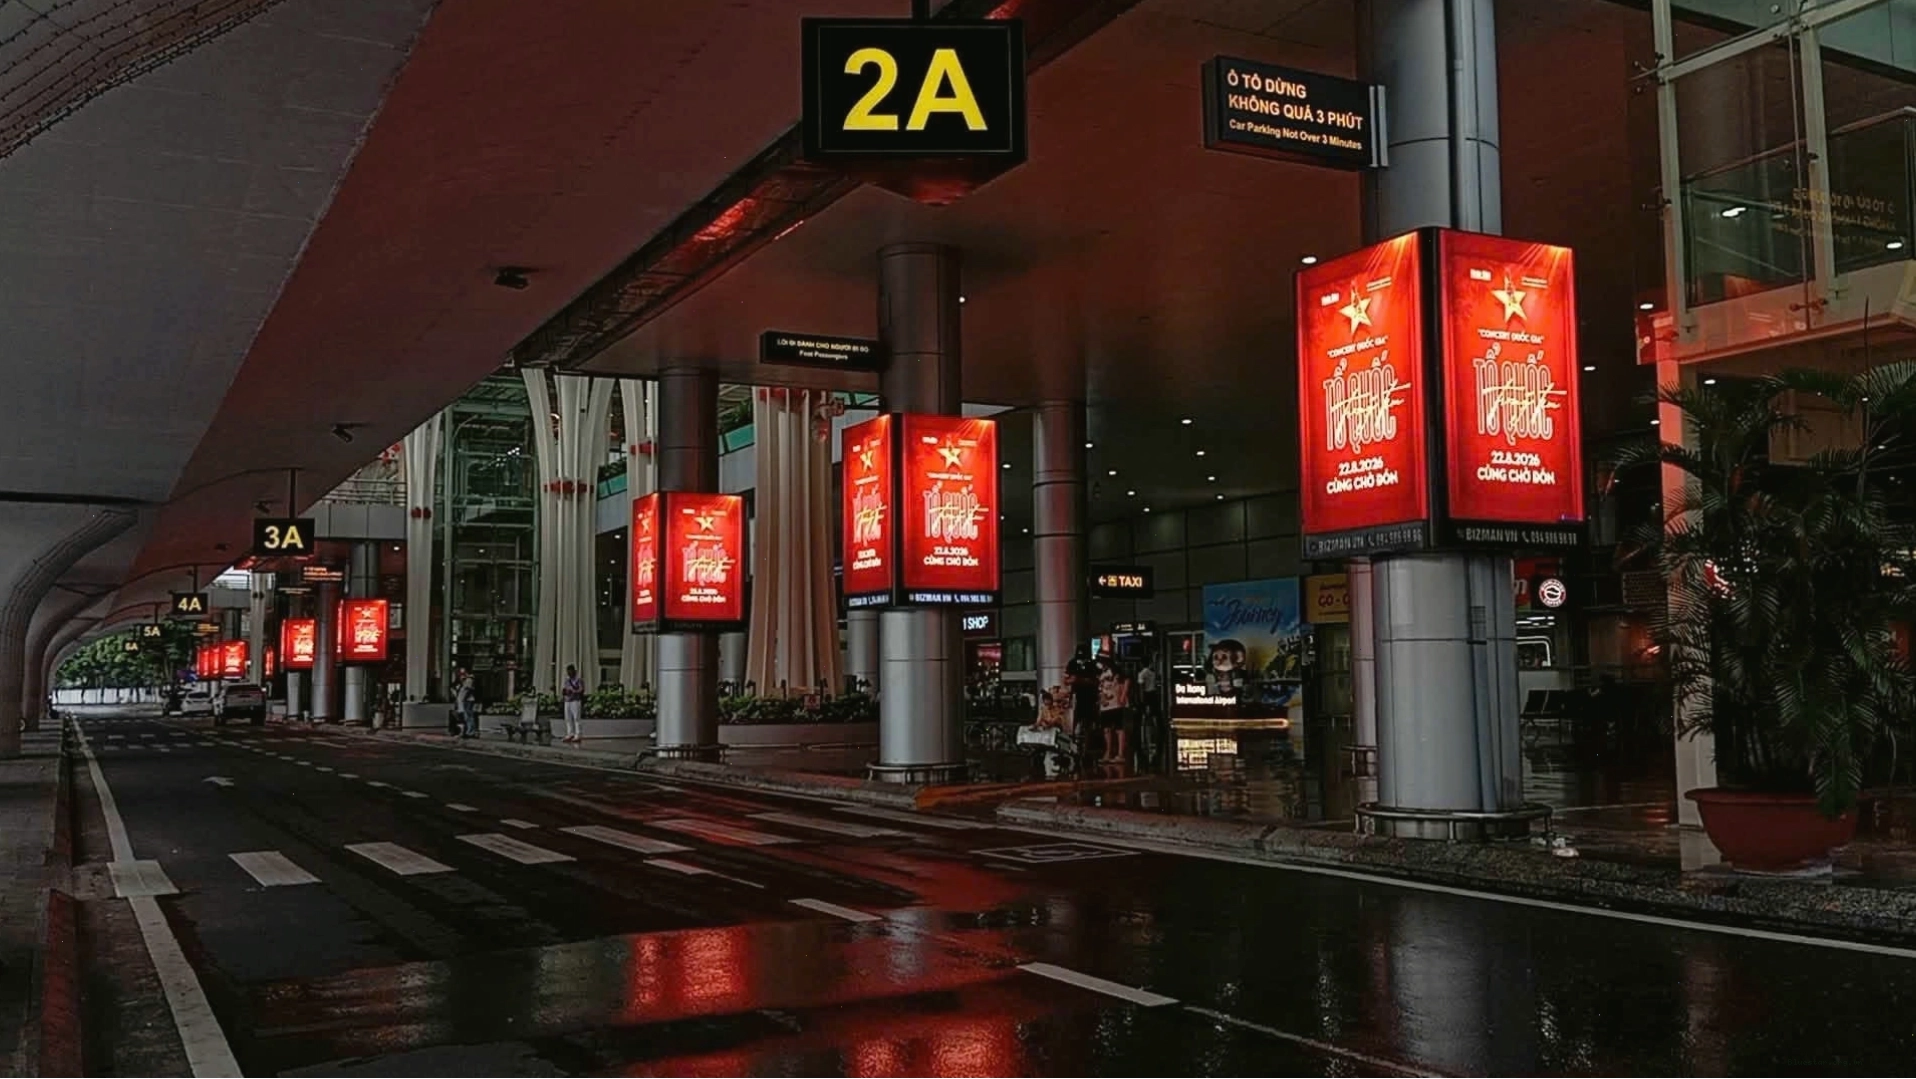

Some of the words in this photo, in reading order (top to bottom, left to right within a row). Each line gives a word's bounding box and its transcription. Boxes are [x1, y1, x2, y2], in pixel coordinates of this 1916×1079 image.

[843, 48, 978, 131] 2A
[1227, 68, 1239, 87] Ô
[1242, 73, 1262, 91] TÔ
[1265, 76, 1307, 99] DỪNG
[1228, 93, 1280, 116] KHÔNG
[1283, 103, 1315, 124] QUÁ
[1316, 109, 1325, 125] 3
[1327, 111, 1364, 131] PHÚT
[1229, 118, 1246, 131] Car
[1246, 121, 1281, 139] Parking
[1282, 126, 1299, 139] Not
[1299, 130, 1321, 144] Over
[1322, 134, 1328, 145] 3
[1329, 135, 1363, 151] Minutes
[1477, 464, 1507, 483] CÙNG
[1326, 476, 1353, 494] CÙNG
[263, 524, 304, 550] 3A
[1118, 575, 1142, 588] TAXI
[177, 596, 203, 612] 4A
[143, 625, 162, 638] 5A
[967, 615, 989, 631] SHOP
